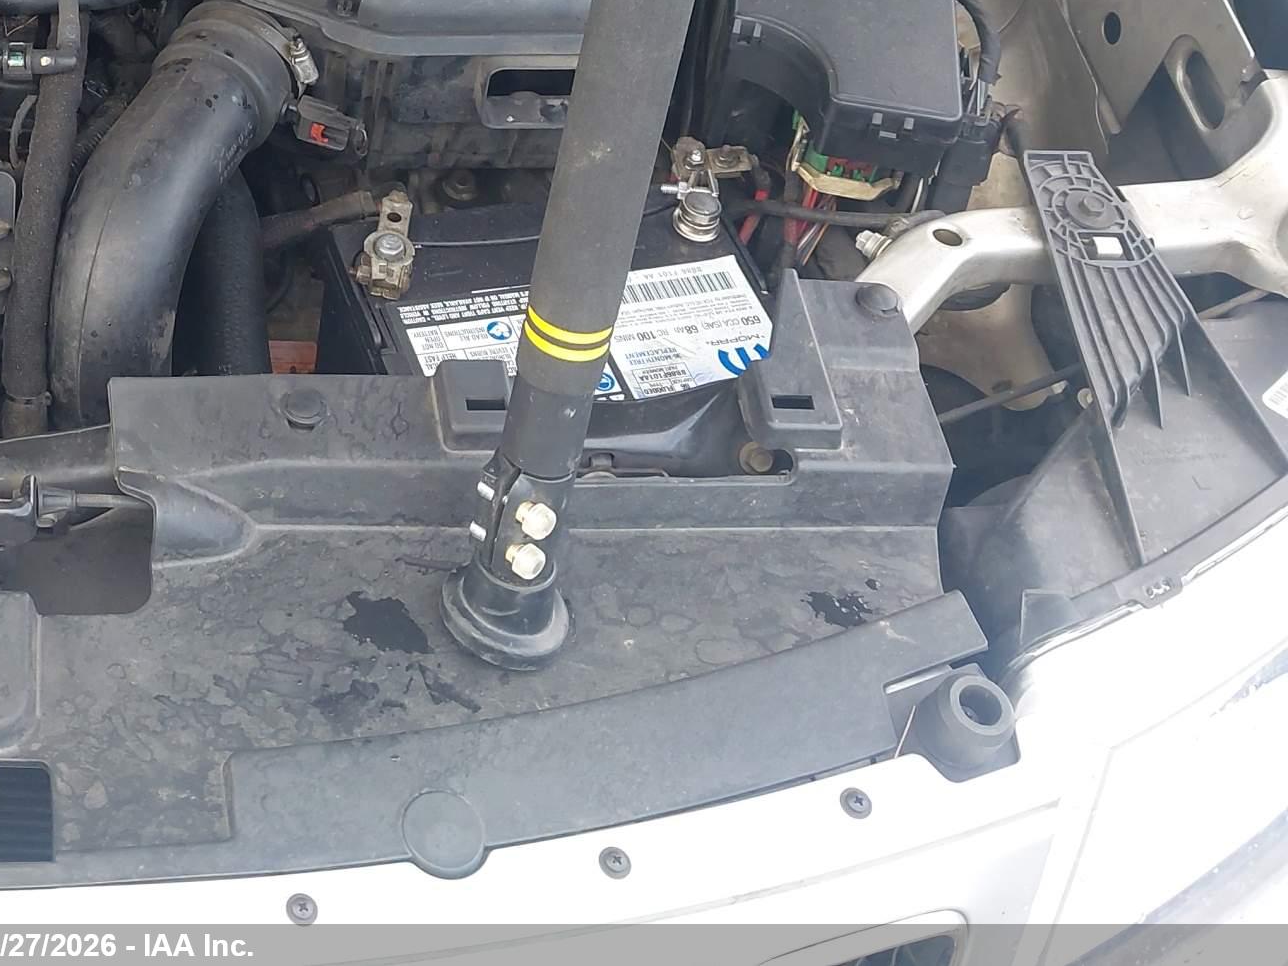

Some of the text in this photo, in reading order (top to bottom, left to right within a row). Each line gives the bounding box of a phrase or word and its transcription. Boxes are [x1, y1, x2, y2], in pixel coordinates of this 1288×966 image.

[722, 318, 739, 326] CCA
[740, 315, 761, 325] 650
[443, 326, 485, 336] INSTRUCTIONS
[636, 330, 656, 341] 100
[624, 346, 676, 359] REPLACEMENT
[423, 354, 439, 362] FAST
